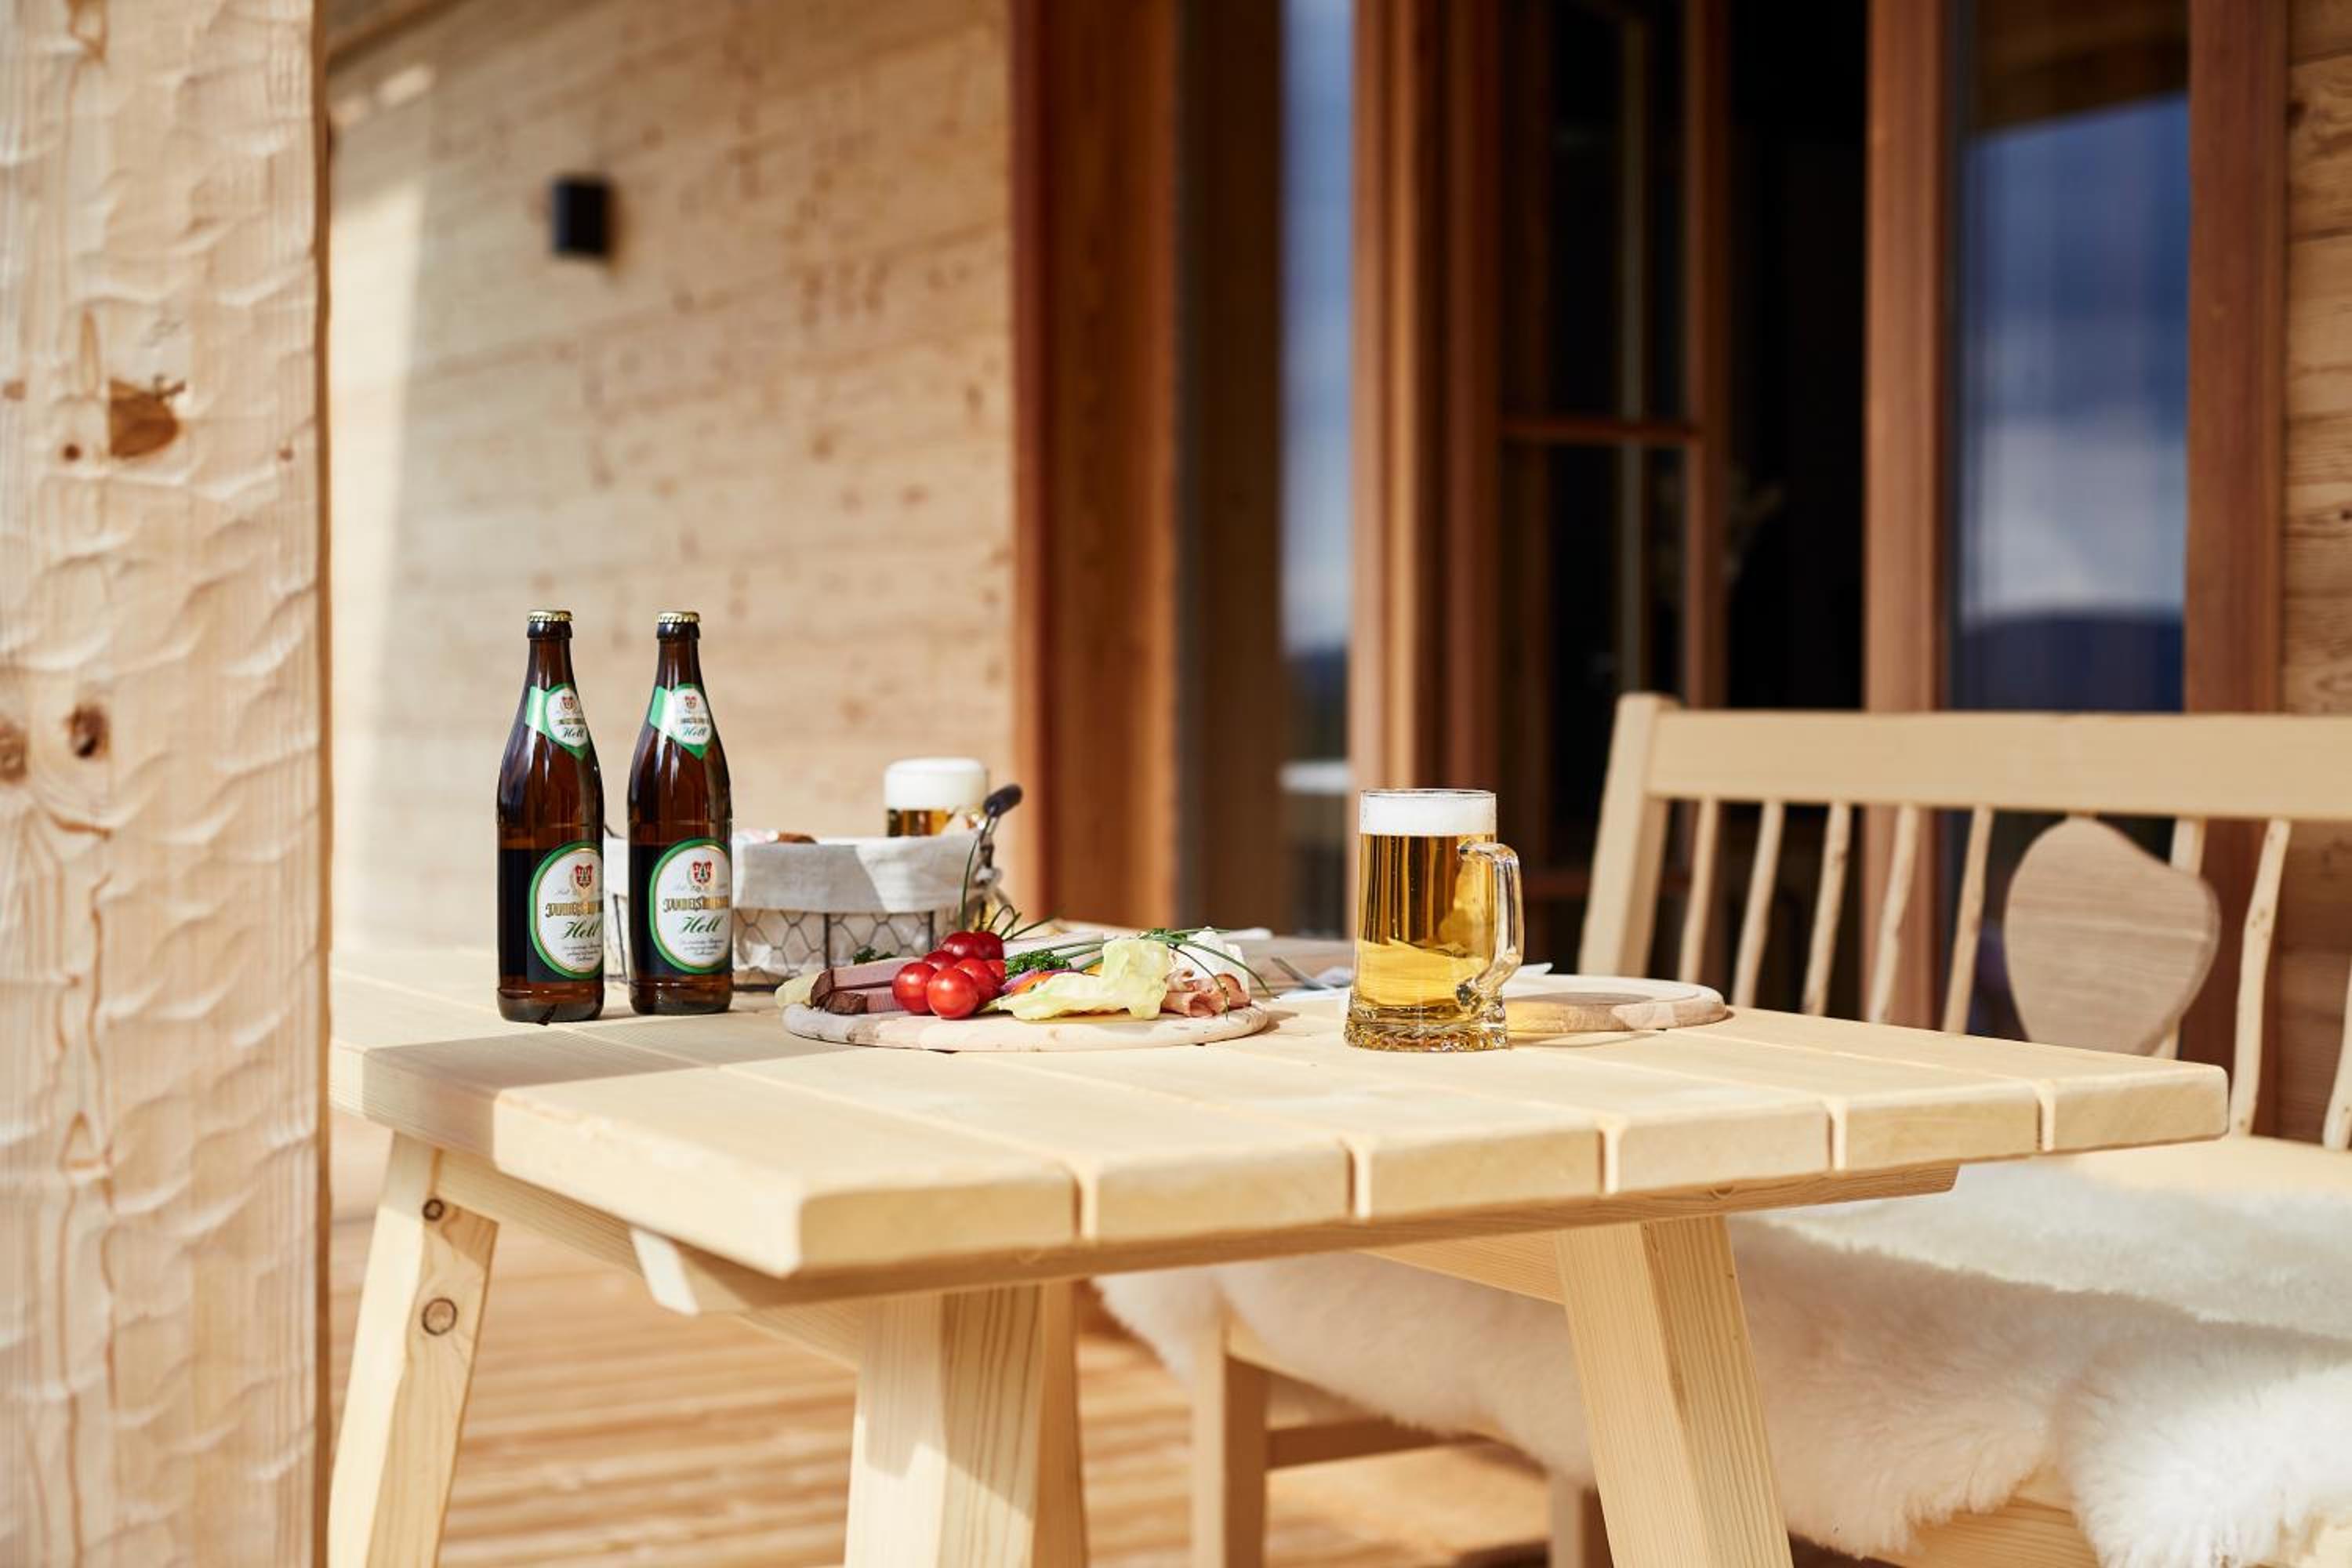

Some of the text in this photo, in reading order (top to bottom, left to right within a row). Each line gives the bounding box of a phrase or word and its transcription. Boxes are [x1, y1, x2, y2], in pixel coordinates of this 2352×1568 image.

[563, 727, 585, 738] Hell
[564, 919, 602, 938] Hell
[681, 916, 721, 933] Hell
